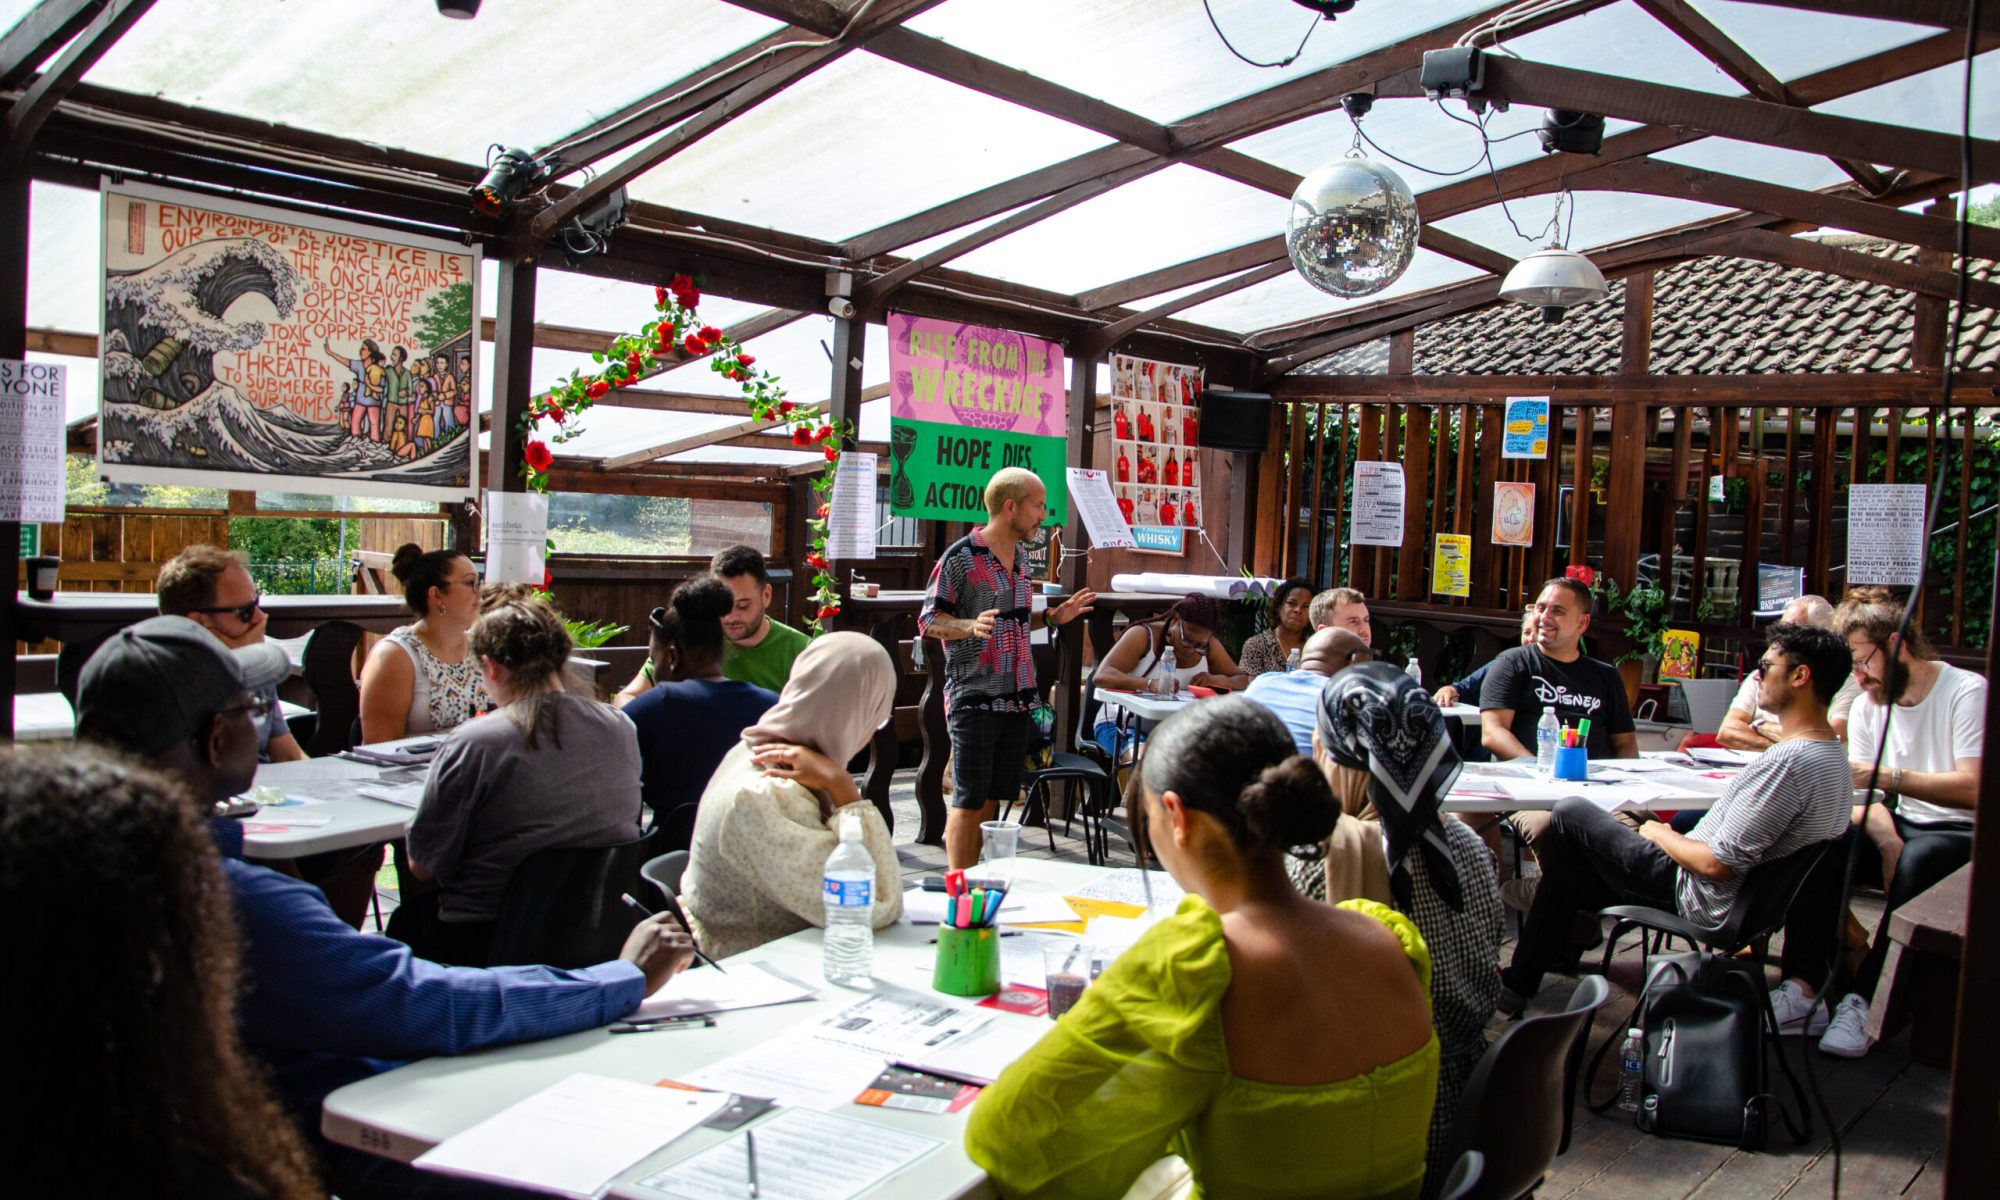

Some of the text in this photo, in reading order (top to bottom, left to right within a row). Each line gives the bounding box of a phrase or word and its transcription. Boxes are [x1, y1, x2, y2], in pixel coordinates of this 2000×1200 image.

[160, 204, 316, 239] ENVIRONMENTAL
[327, 235, 427, 267] JUSTICE
[441, 254, 462, 271] IS
[162, 227, 204, 253] OUR
[217, 228, 265, 237] CRY
[269, 231, 289, 244] OF
[298, 238, 380, 277] DEFIANCE
[386, 263, 463, 288] AGAINST
[290, 250, 424, 302] THE ONSLAUGHT
[312, 281, 326, 291] OF
[304, 289, 412, 322] OPPRESIVE
[295, 309, 407, 333] TOXINS AND
[264, 340, 311, 356] THAT
[269, 323, 418, 350] TOXIC OPPRESSIONS
[236, 352, 331, 378] THREATEN
[909, 331, 1046, 377] RISE FROM THE
[21, 364, 59, 380] FOR
[223, 366, 334, 395] TO SUBMERGE
[1, 378, 59, 397] YONE
[911, 365, 1044, 417] WRECKAGE
[248, 390, 338, 421] OUR HOMES.
[937, 435, 992, 469] HOPE
[1138, 532, 1178, 546] WHISKY
[1029, 546, 1047, 561] STOUT
[1850, 575, 1874, 583] FROM
